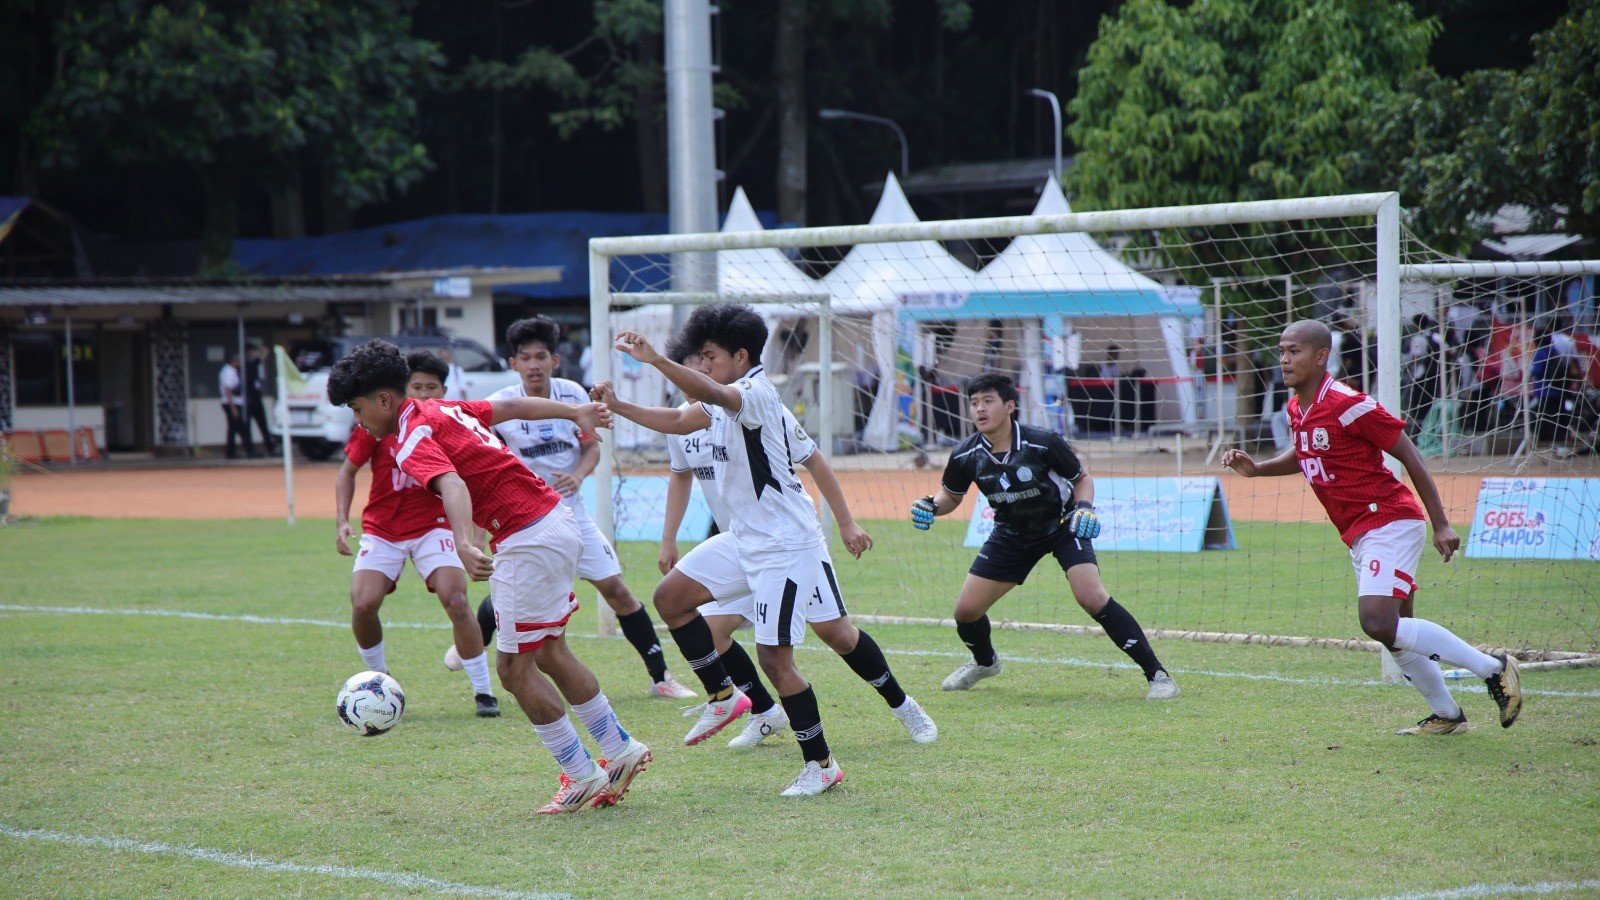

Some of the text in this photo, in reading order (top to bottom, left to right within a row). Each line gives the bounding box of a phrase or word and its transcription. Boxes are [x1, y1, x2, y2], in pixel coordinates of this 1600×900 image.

[521, 422, 529, 434] 4
[684, 438, 700, 453] 24
[1484, 511, 1525, 528] GOES
[438, 538, 454, 551] 19
[1480, 529, 1545, 546] CAMPUS
[603, 545, 614, 559] 4
[1369, 559, 1381, 577] 9
[756, 601, 768, 624] 14
